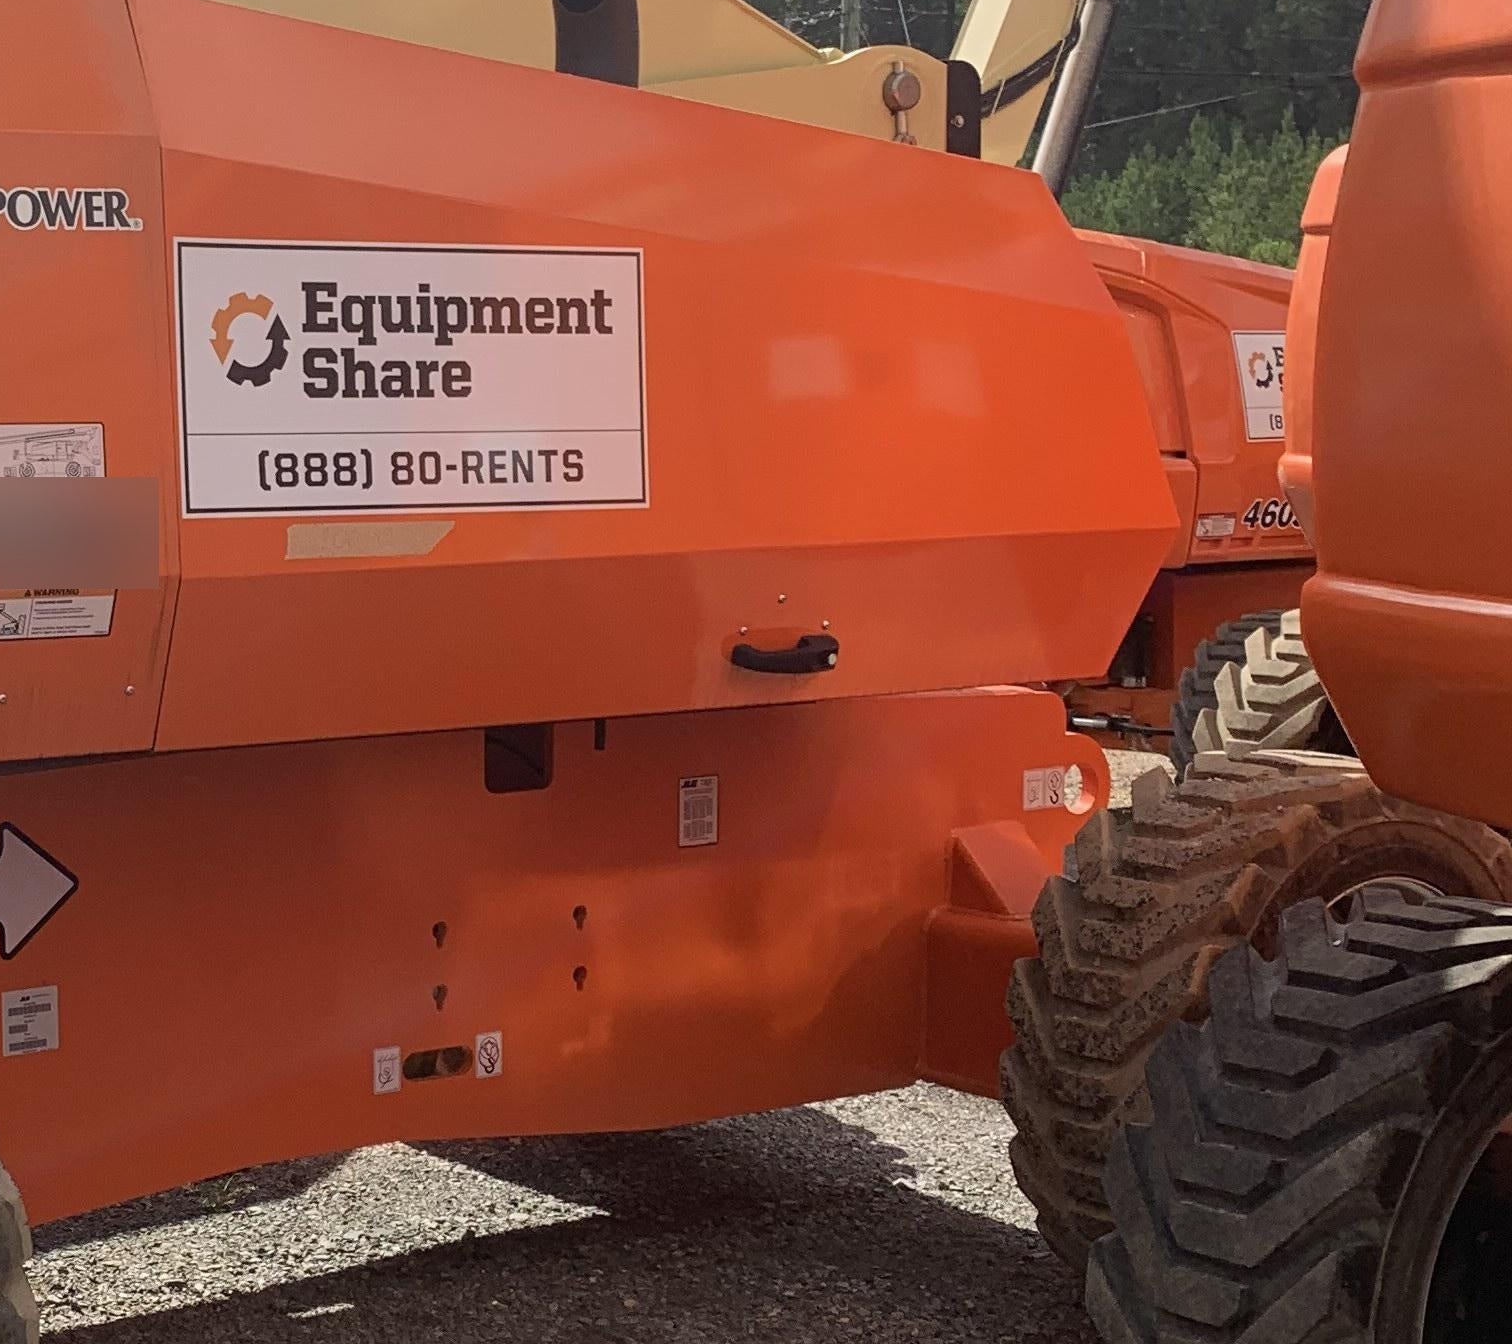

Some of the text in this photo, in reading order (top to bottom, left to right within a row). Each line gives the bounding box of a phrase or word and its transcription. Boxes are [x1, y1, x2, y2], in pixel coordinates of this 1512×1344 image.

[301, 281, 613, 346] Equipment
[302, 347, 473, 398] Share
[258, 449, 584, 491] (888) 80-RENTS
[1242, 499, 1300, 528] 460
